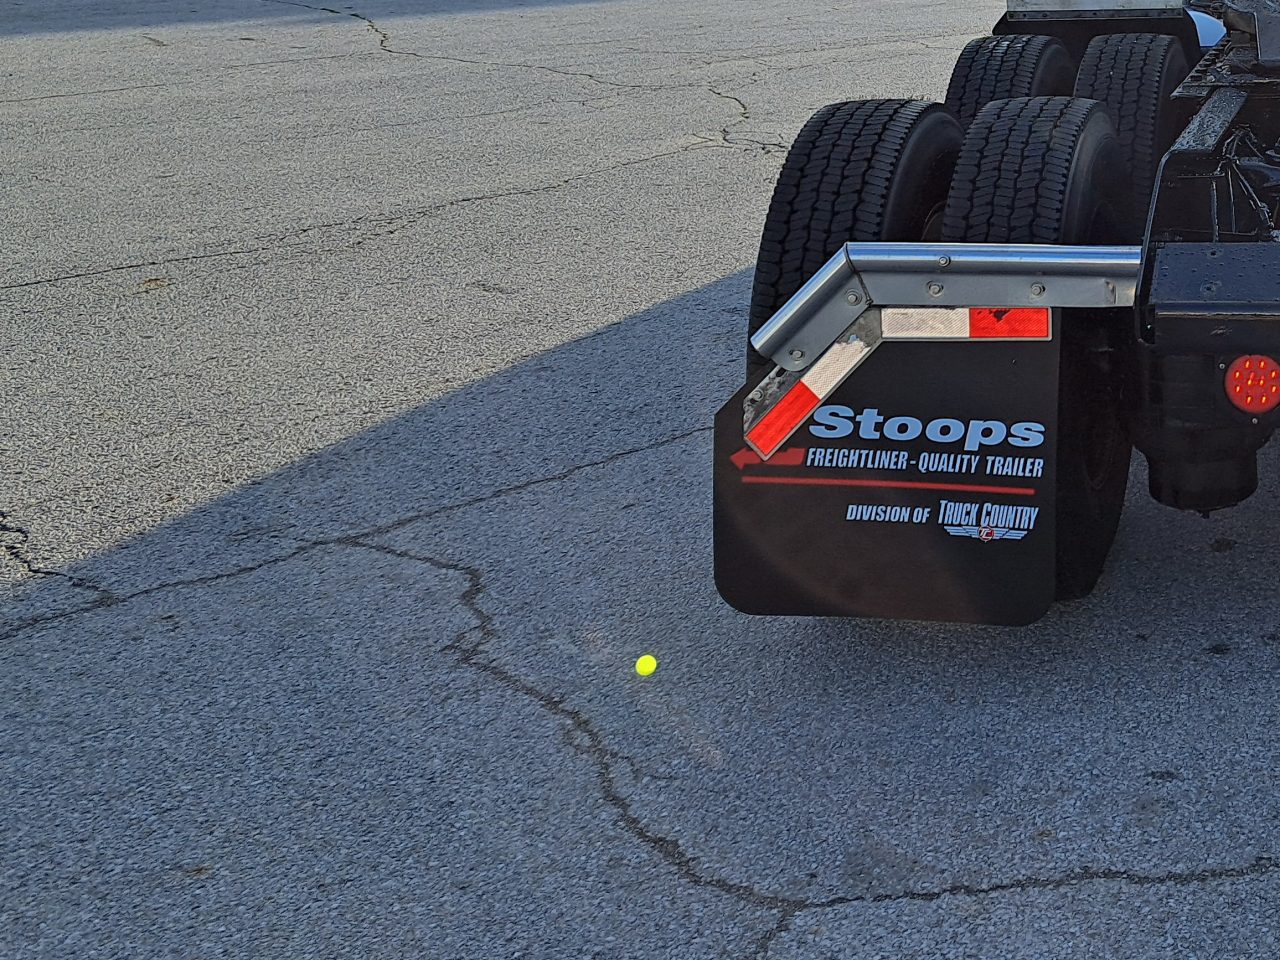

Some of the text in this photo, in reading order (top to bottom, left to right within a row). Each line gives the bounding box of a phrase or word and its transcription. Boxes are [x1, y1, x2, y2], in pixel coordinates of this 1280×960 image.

[809, 404, 1046, 451] Stoops
[806, 448, 908, 470] FREIGHTLINER
[918, 452, 980, 474] QUALITY
[985, 455, 1044, 478] TRAILER
[846, 499, 1039, 529] DIVISION OF TRUCK COUNTRY
